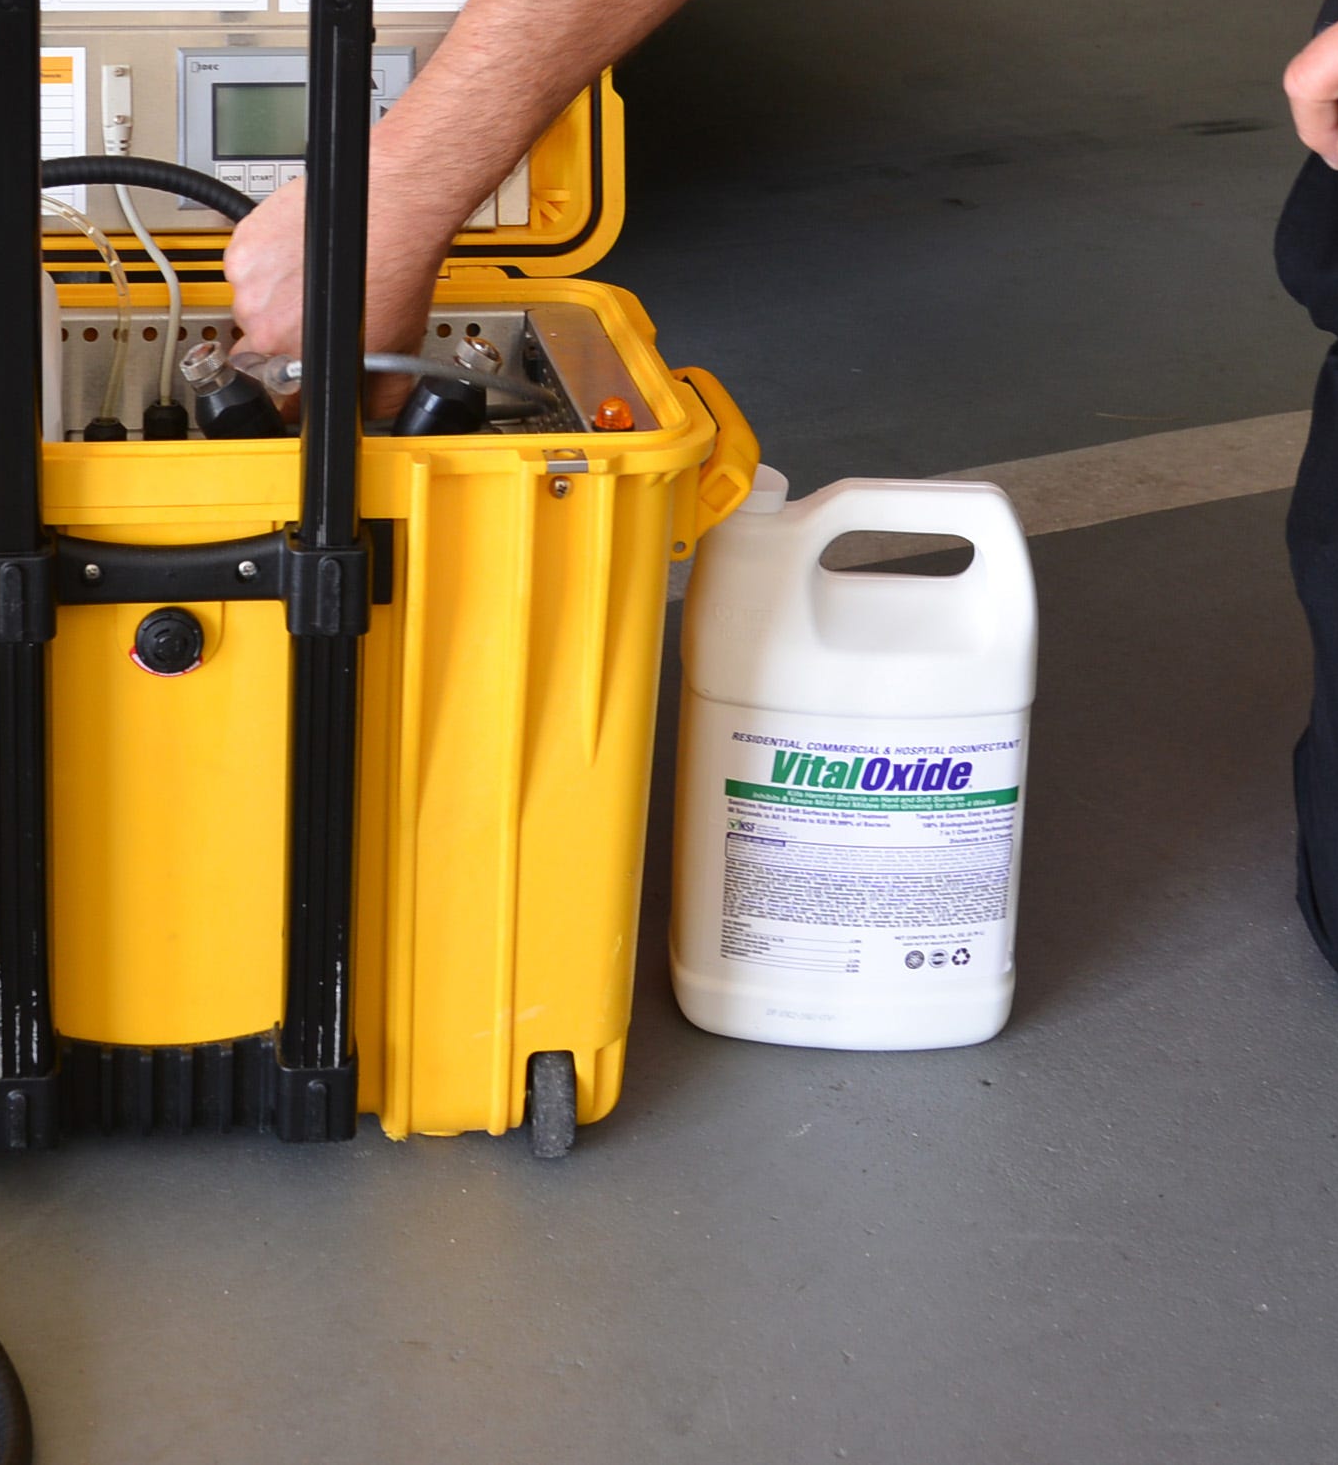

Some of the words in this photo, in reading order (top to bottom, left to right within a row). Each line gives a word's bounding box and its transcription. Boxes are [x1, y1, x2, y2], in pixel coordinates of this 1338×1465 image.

[807, 741, 879, 755] COMMERCIAL
[883, 746, 891, 755] &
[895, 746, 945, 755] HOSPITAL
[948, 738, 1021, 755] DISINFECTANT
[770, 749, 973, 792] VitalOxide
[740, 821, 756, 832] NSF
